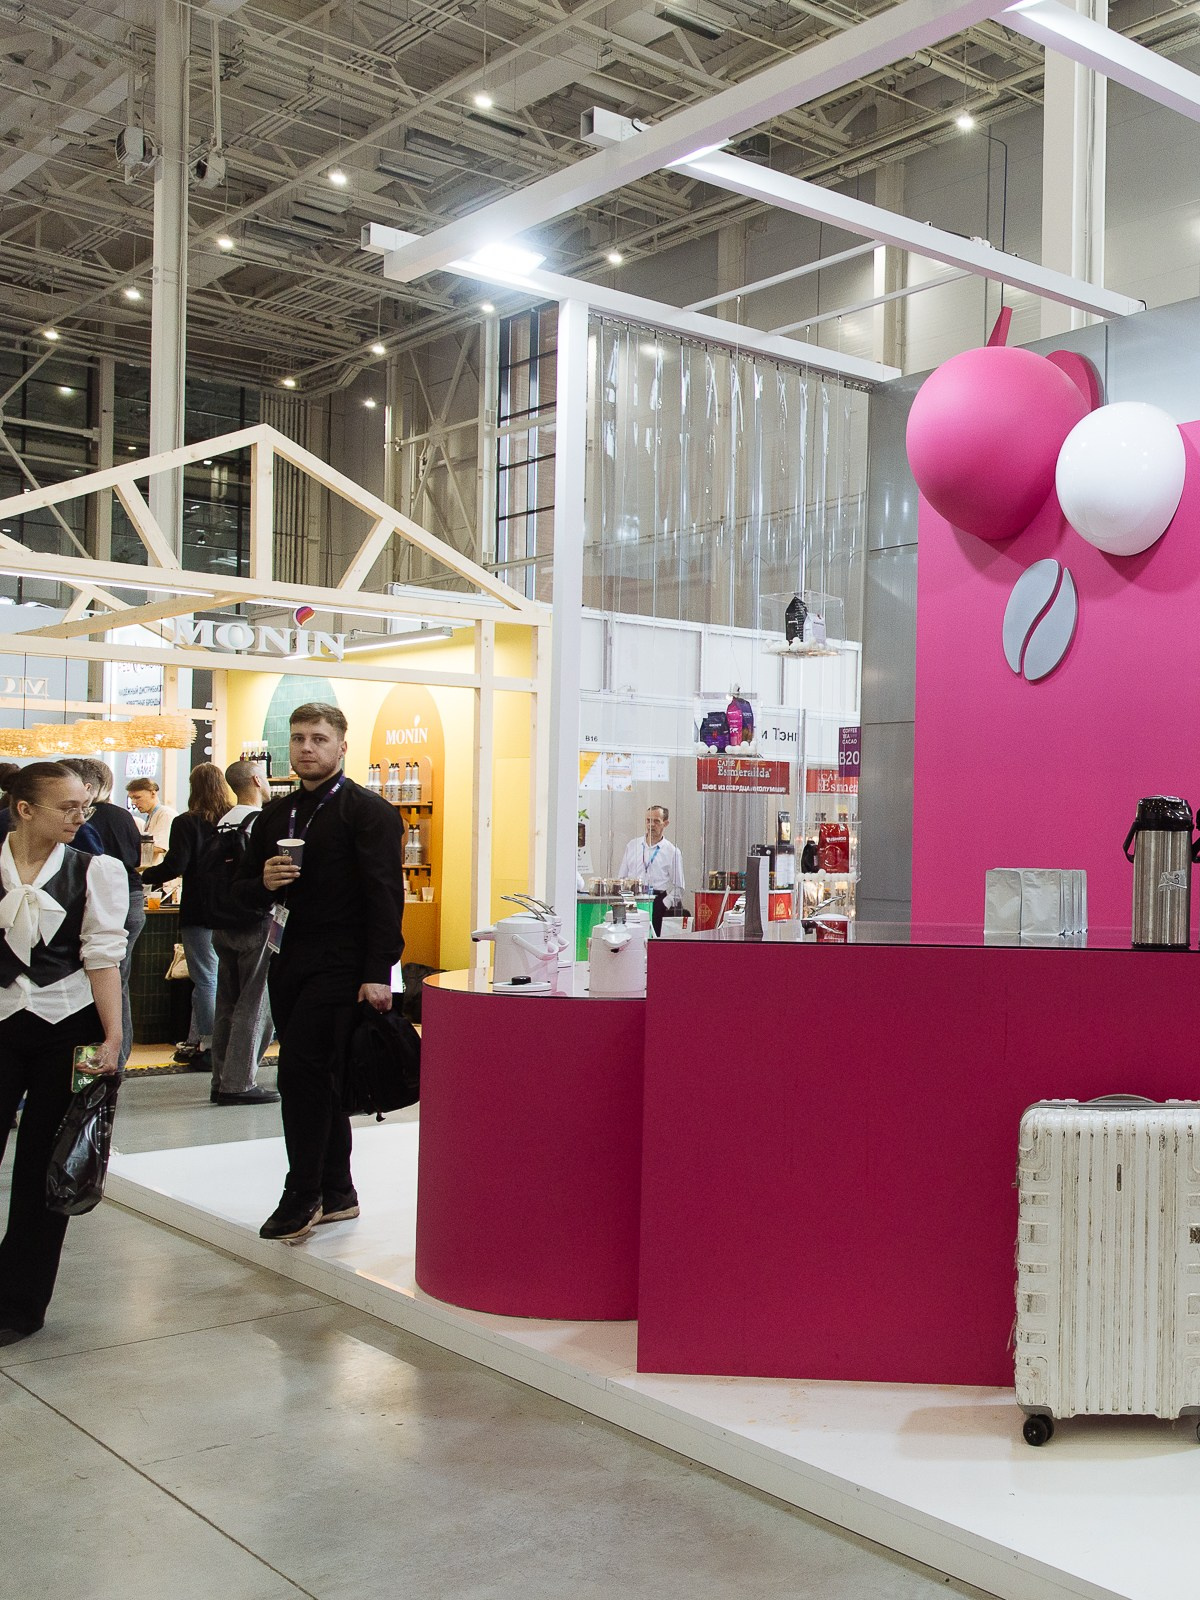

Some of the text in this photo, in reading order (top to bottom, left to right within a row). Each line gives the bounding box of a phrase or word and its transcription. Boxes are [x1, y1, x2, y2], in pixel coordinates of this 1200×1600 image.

[172, 616, 349, 662] MONIN
[385, 727, 428, 745] MONIN
[839, 751, 860, 766] B20
